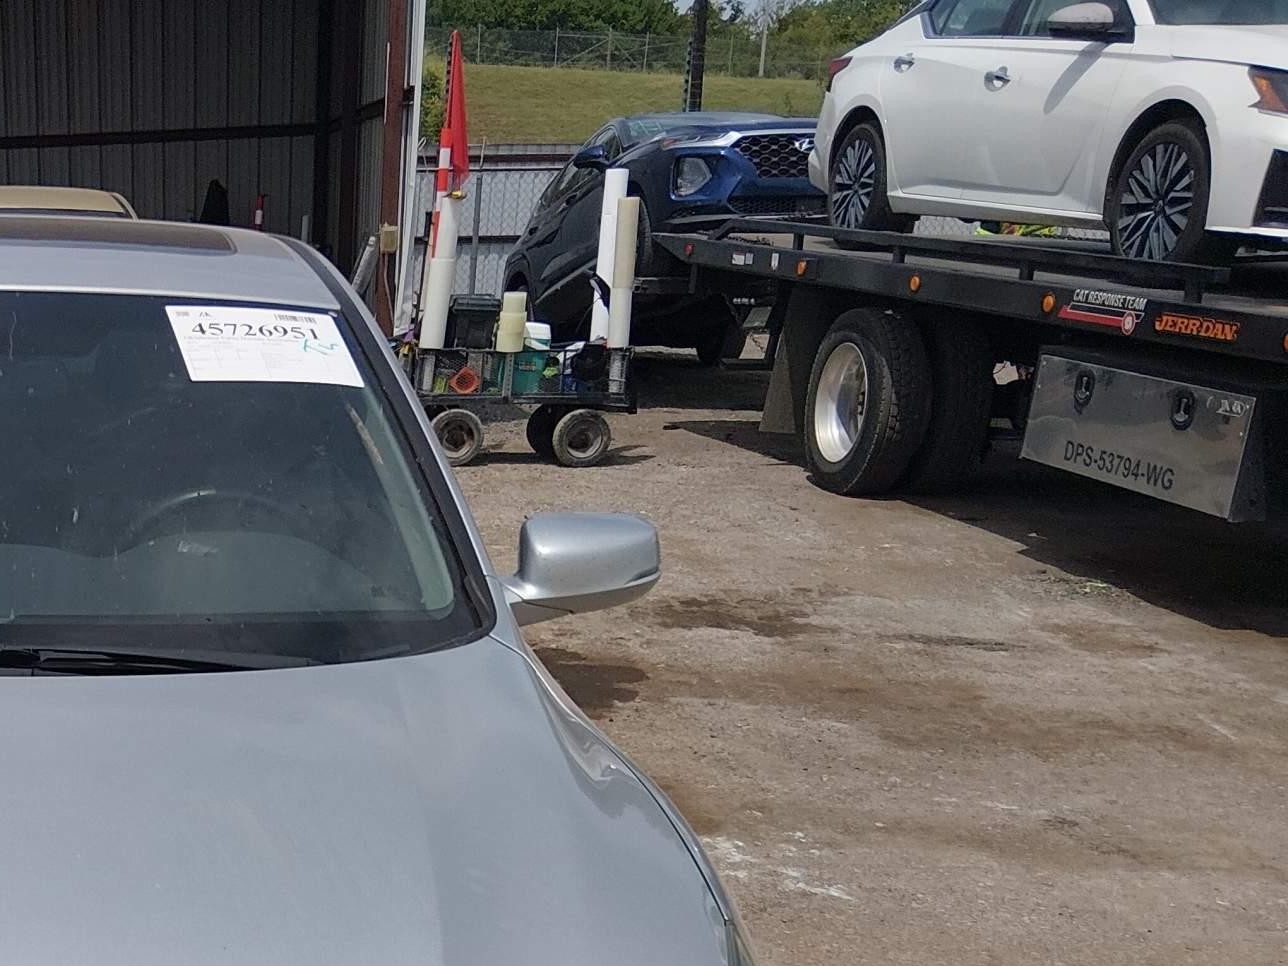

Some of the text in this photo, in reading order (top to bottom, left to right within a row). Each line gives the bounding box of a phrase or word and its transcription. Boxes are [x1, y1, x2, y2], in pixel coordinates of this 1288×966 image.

[1073, 289, 1148, 311] CAT RESPONSE TEAM
[191, 322, 319, 340] 45726951
[1064, 440, 1175, 491] DPS-53794-WG
